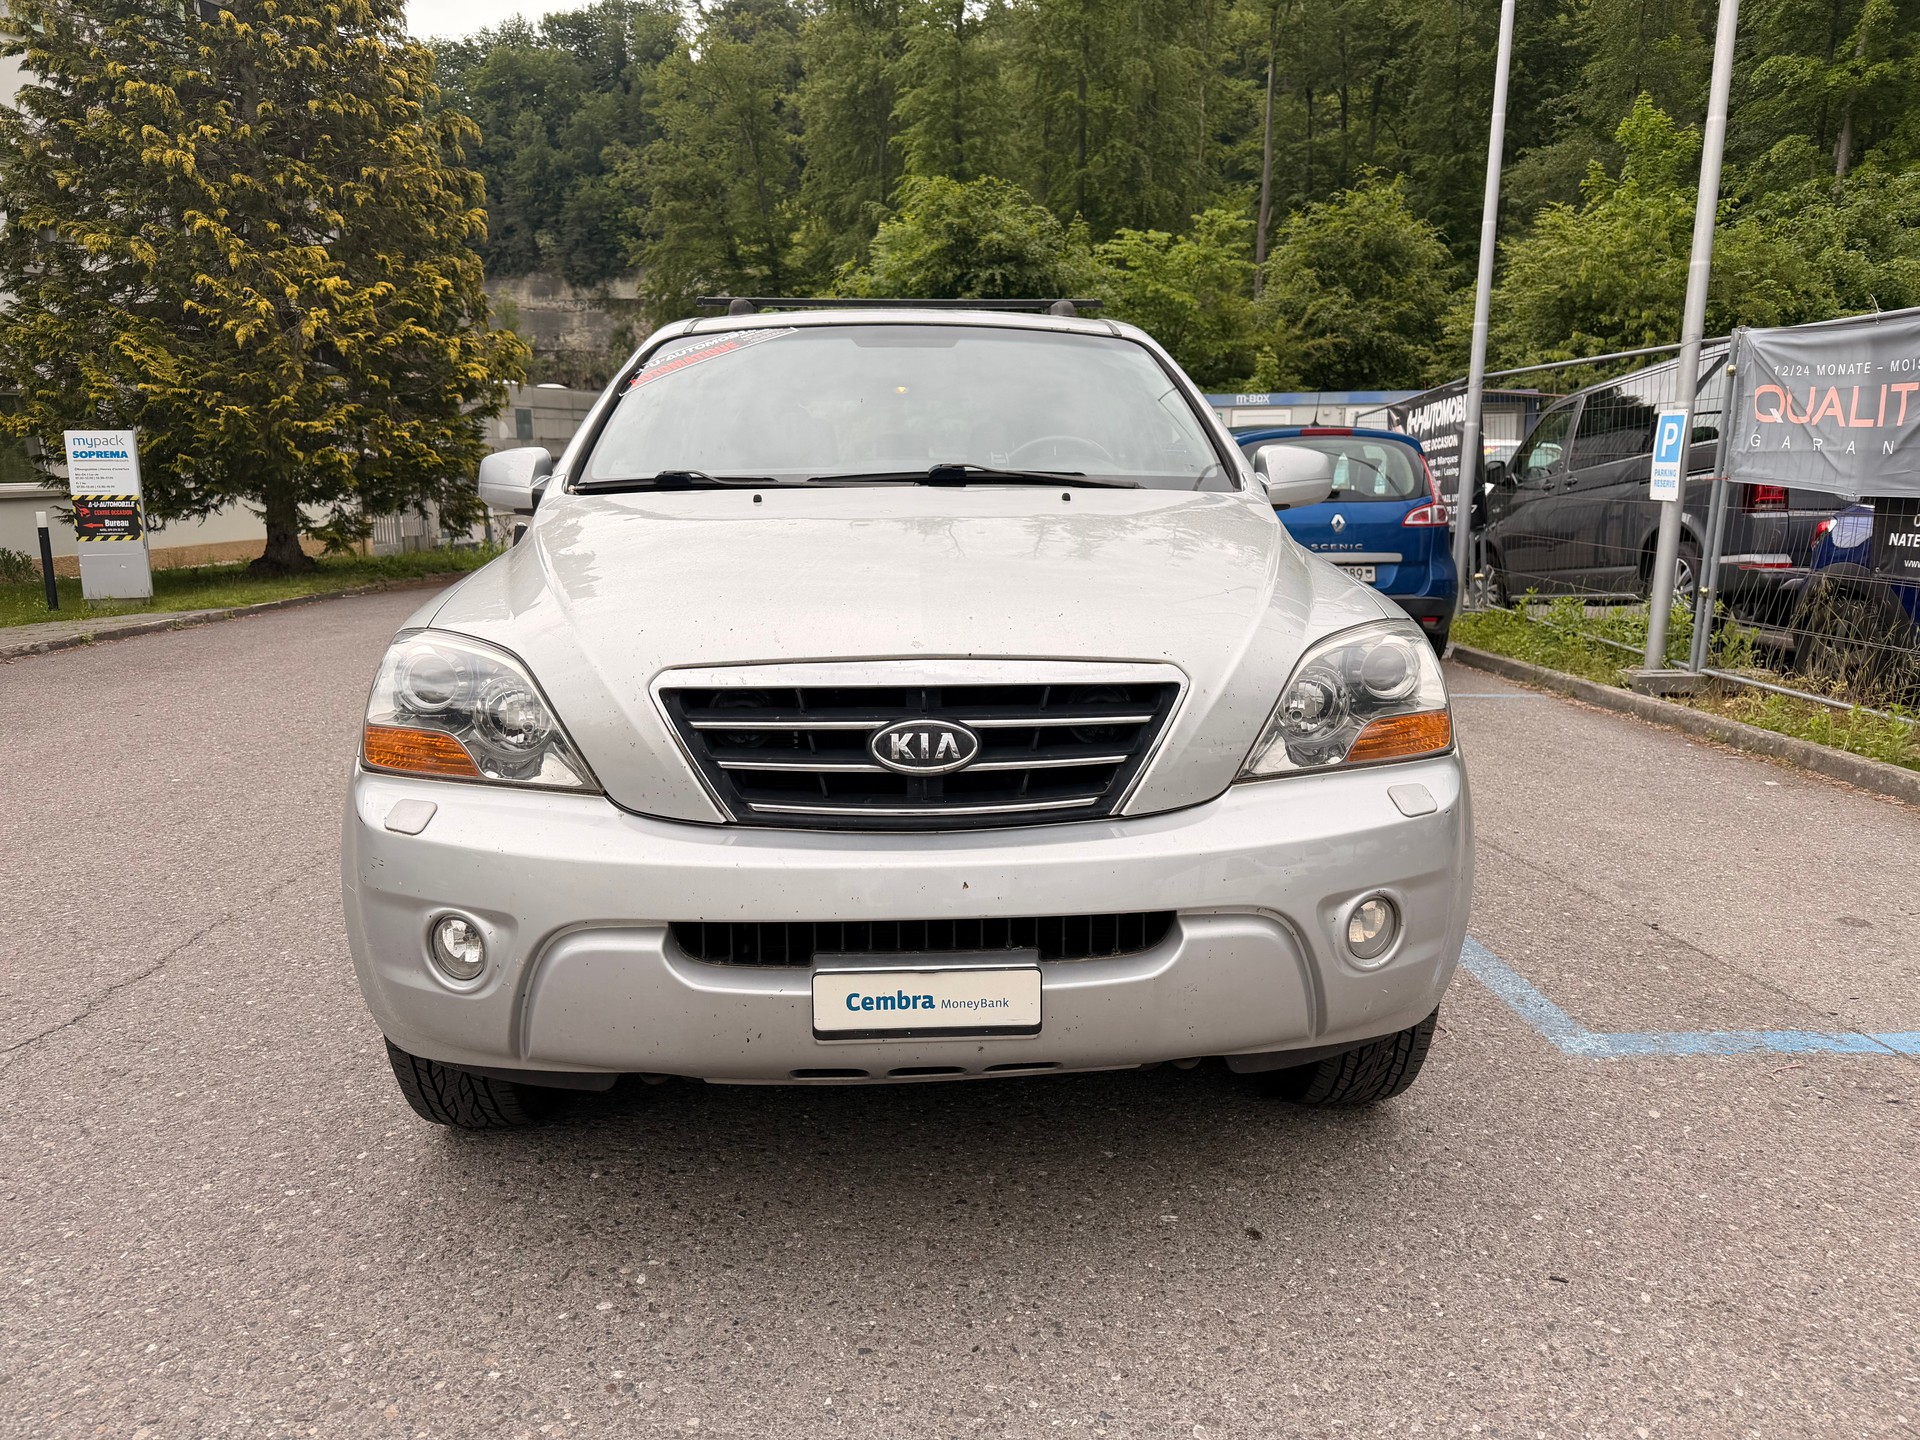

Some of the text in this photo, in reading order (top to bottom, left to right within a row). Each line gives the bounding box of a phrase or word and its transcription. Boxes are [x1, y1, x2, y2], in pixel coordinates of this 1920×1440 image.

[1773, 365, 1810, 376] 12/24
[1817, 362, 1871, 376] MONATE
[73, 435, 124, 448] mypack
[1431, 434, 1459, 451] OCCASION
[1661, 423, 1678, 457] P
[1437, 456, 1459, 465] Marques
[1444, 467, 1459, 476] Leasing
[1654, 469, 1676, 477] PARKING
[105, 519, 129, 527] Bureau
[889, 733, 961, 760] KIA
[846, 990, 1009, 1011] Cembra MoneyBank
